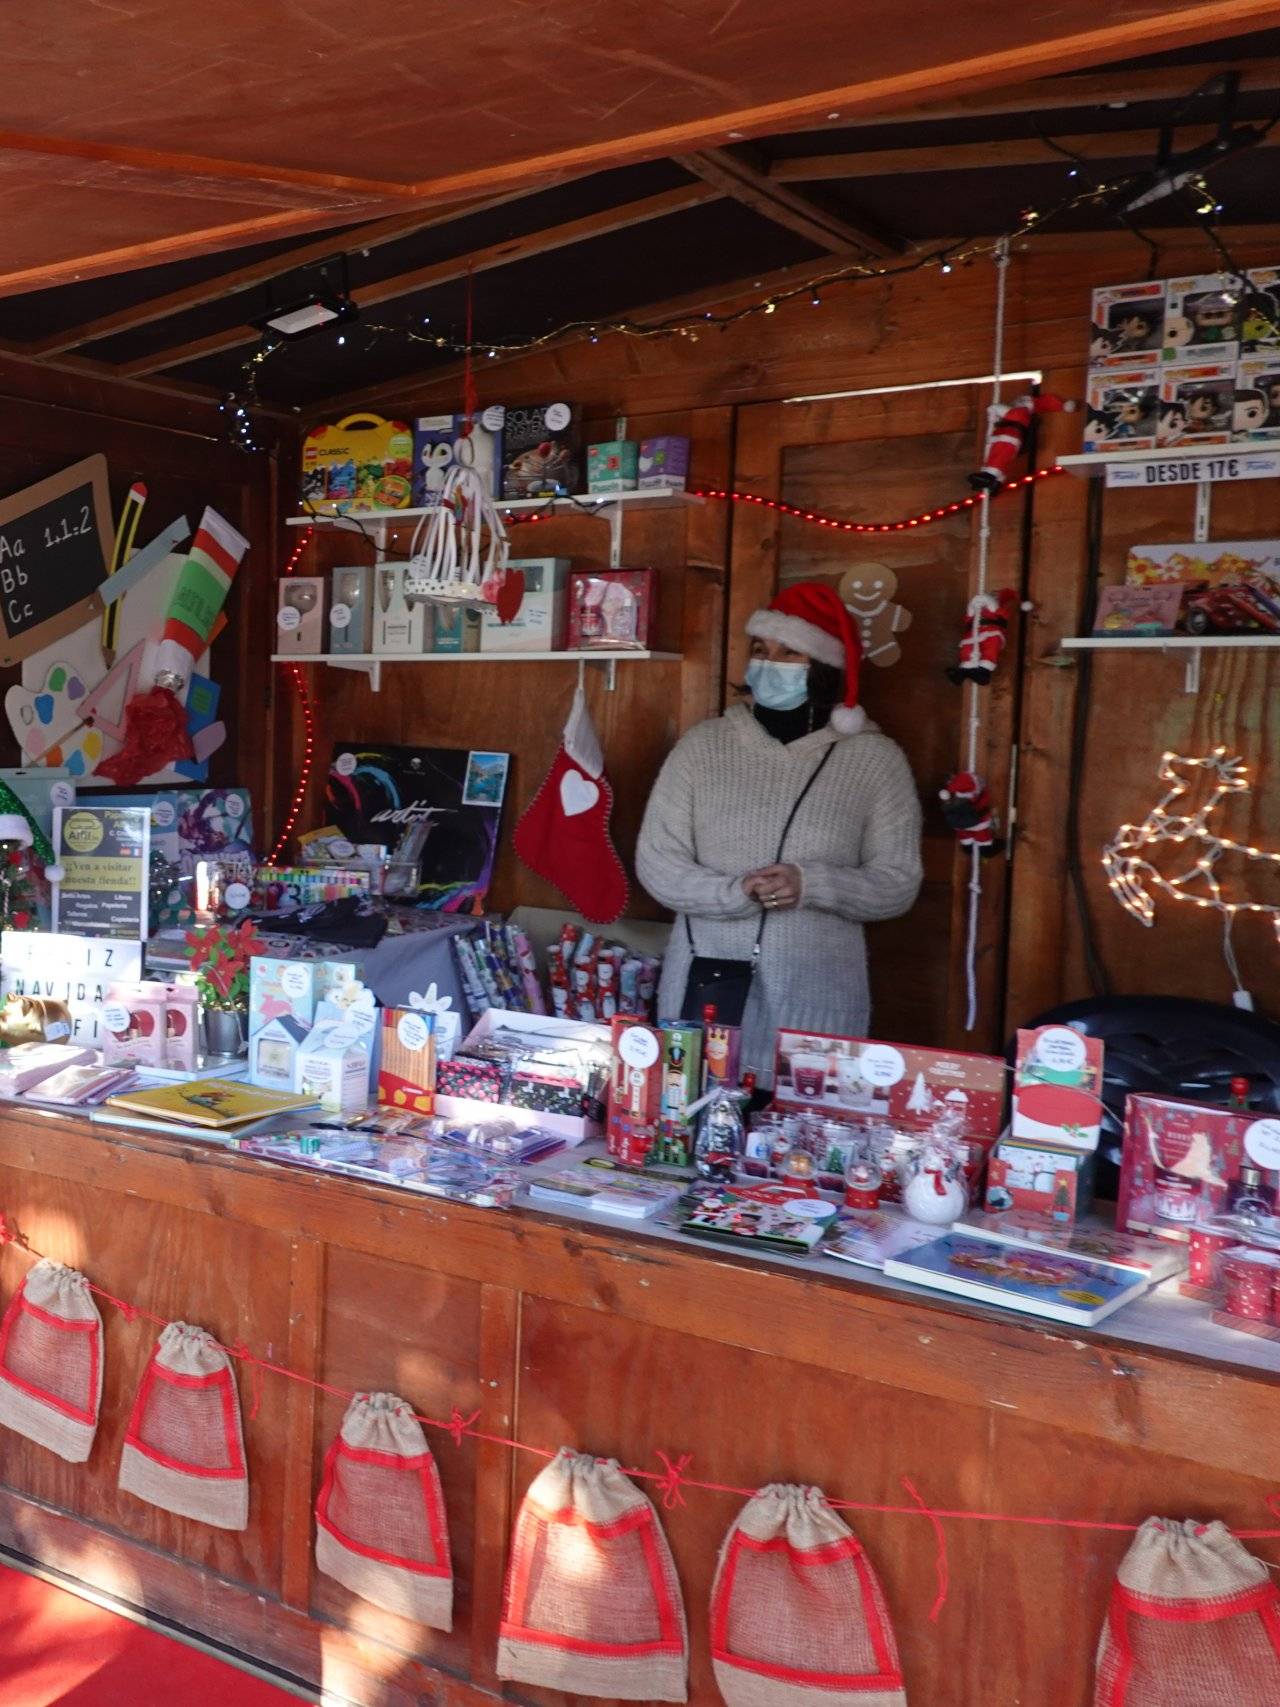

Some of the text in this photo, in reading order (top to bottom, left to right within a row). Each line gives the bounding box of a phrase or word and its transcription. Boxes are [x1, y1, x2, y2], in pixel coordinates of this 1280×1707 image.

[1145, 462, 1201, 483] DESDE
[1207, 459, 1239, 479] 17€
[1, 565, 28, 594] Bb
[8, 599, 33, 623] Cc
[15, 979, 103, 1003] NAVIDA
